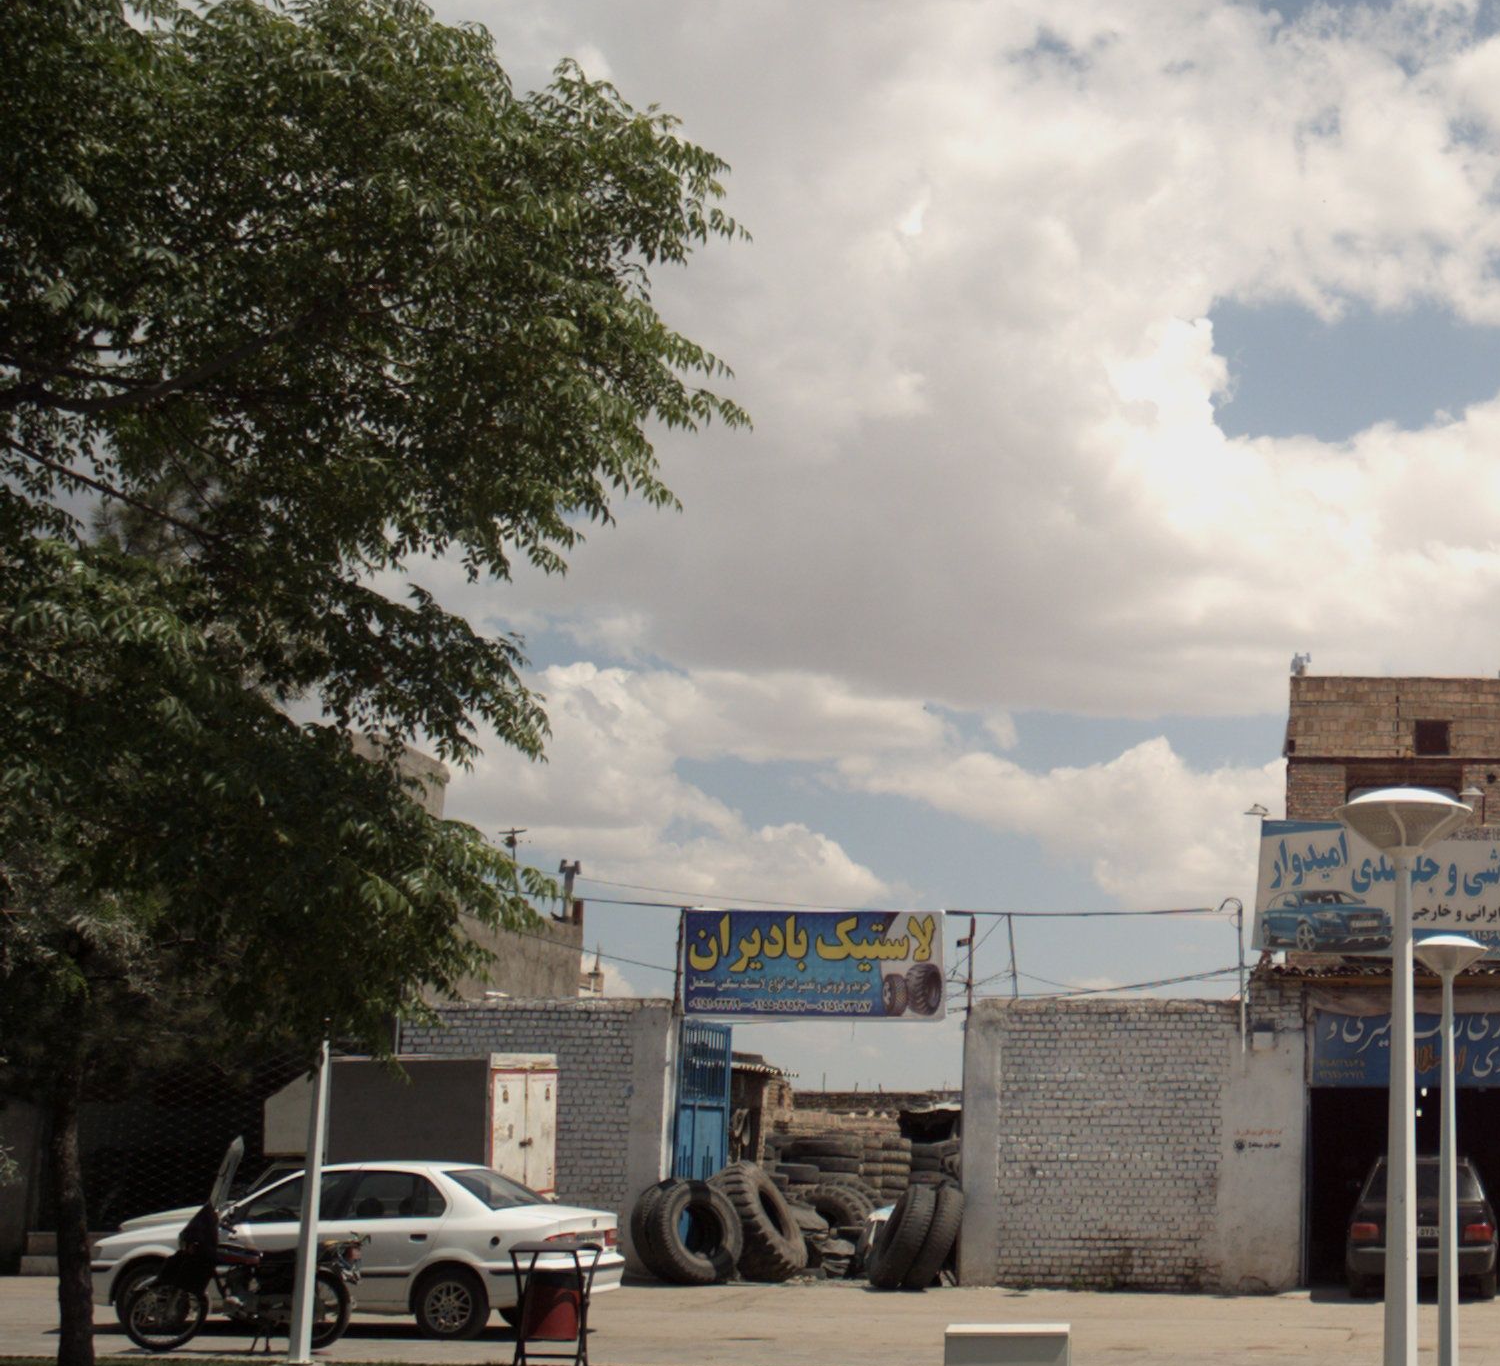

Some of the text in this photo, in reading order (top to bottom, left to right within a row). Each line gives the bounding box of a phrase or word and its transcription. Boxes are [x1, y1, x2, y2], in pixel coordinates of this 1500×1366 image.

[1270, 830, 1350, 890] امیدوار
[1445, 862, 1458, 897] و
[1455, 911, 1462, 922] و
[688, 913, 935, 973] لاستیک بادیران
